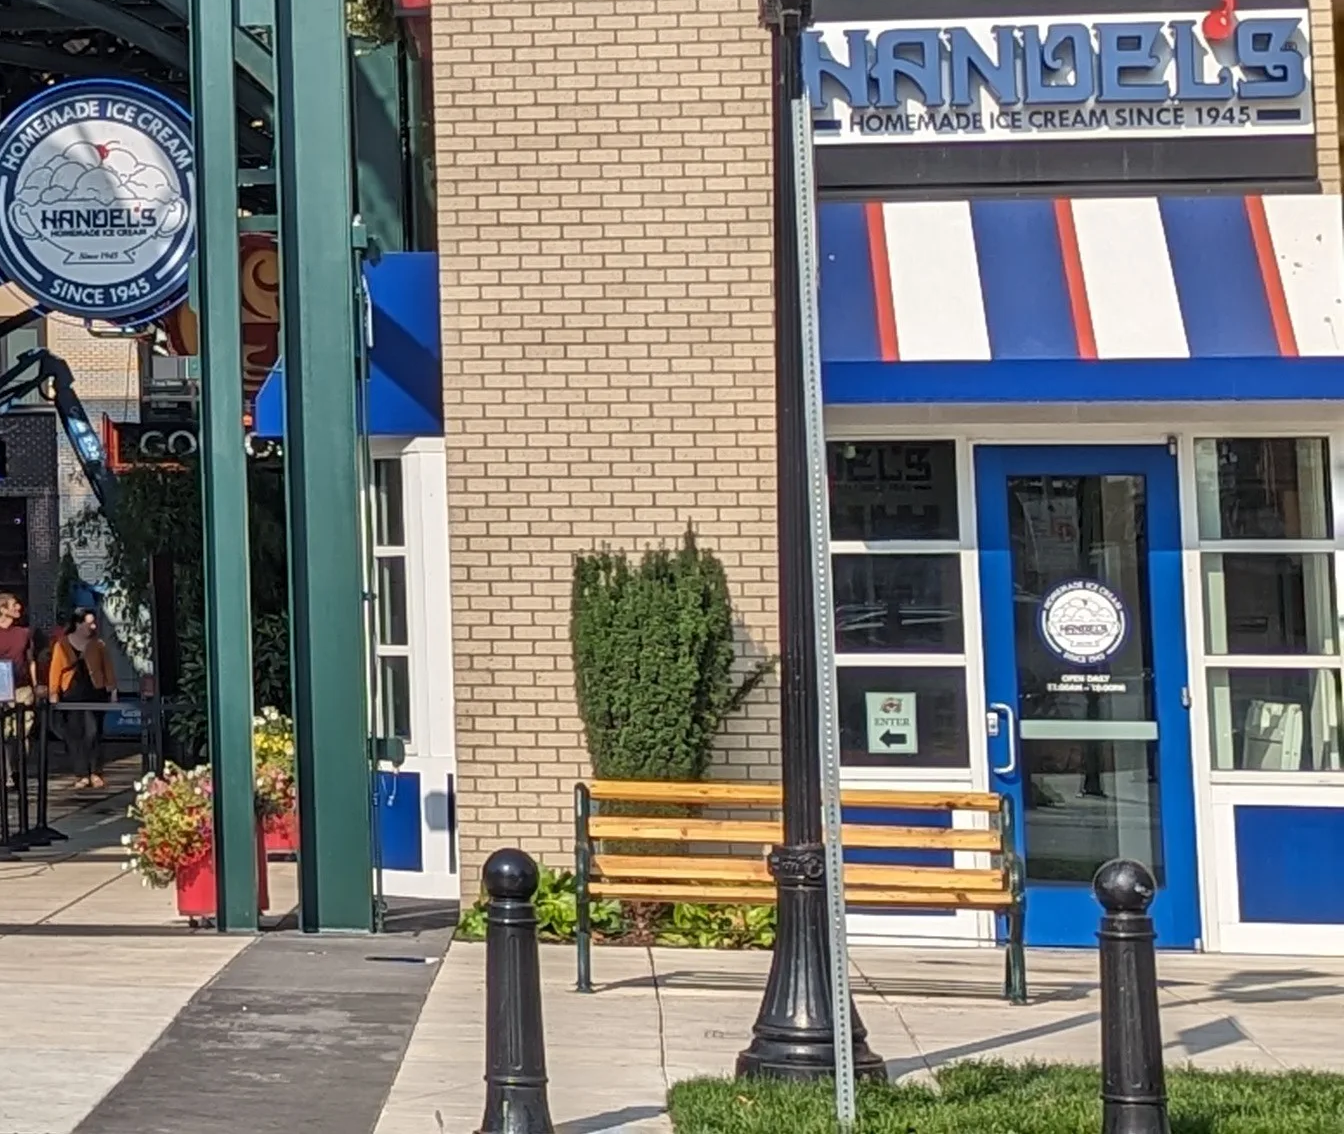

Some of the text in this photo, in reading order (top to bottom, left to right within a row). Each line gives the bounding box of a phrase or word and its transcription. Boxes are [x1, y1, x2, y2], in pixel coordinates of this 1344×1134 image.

[849, 105, 1252, 134] HOMEMADE ICE CREAM SINCE 1945
[1, 100, 192, 171] HOMEMADE ICE CREAM
[40, 204, 158, 229] HANDEL'S
[49, 277, 152, 305] SINCE 1945
[874, 717, 911, 727] ENTER
